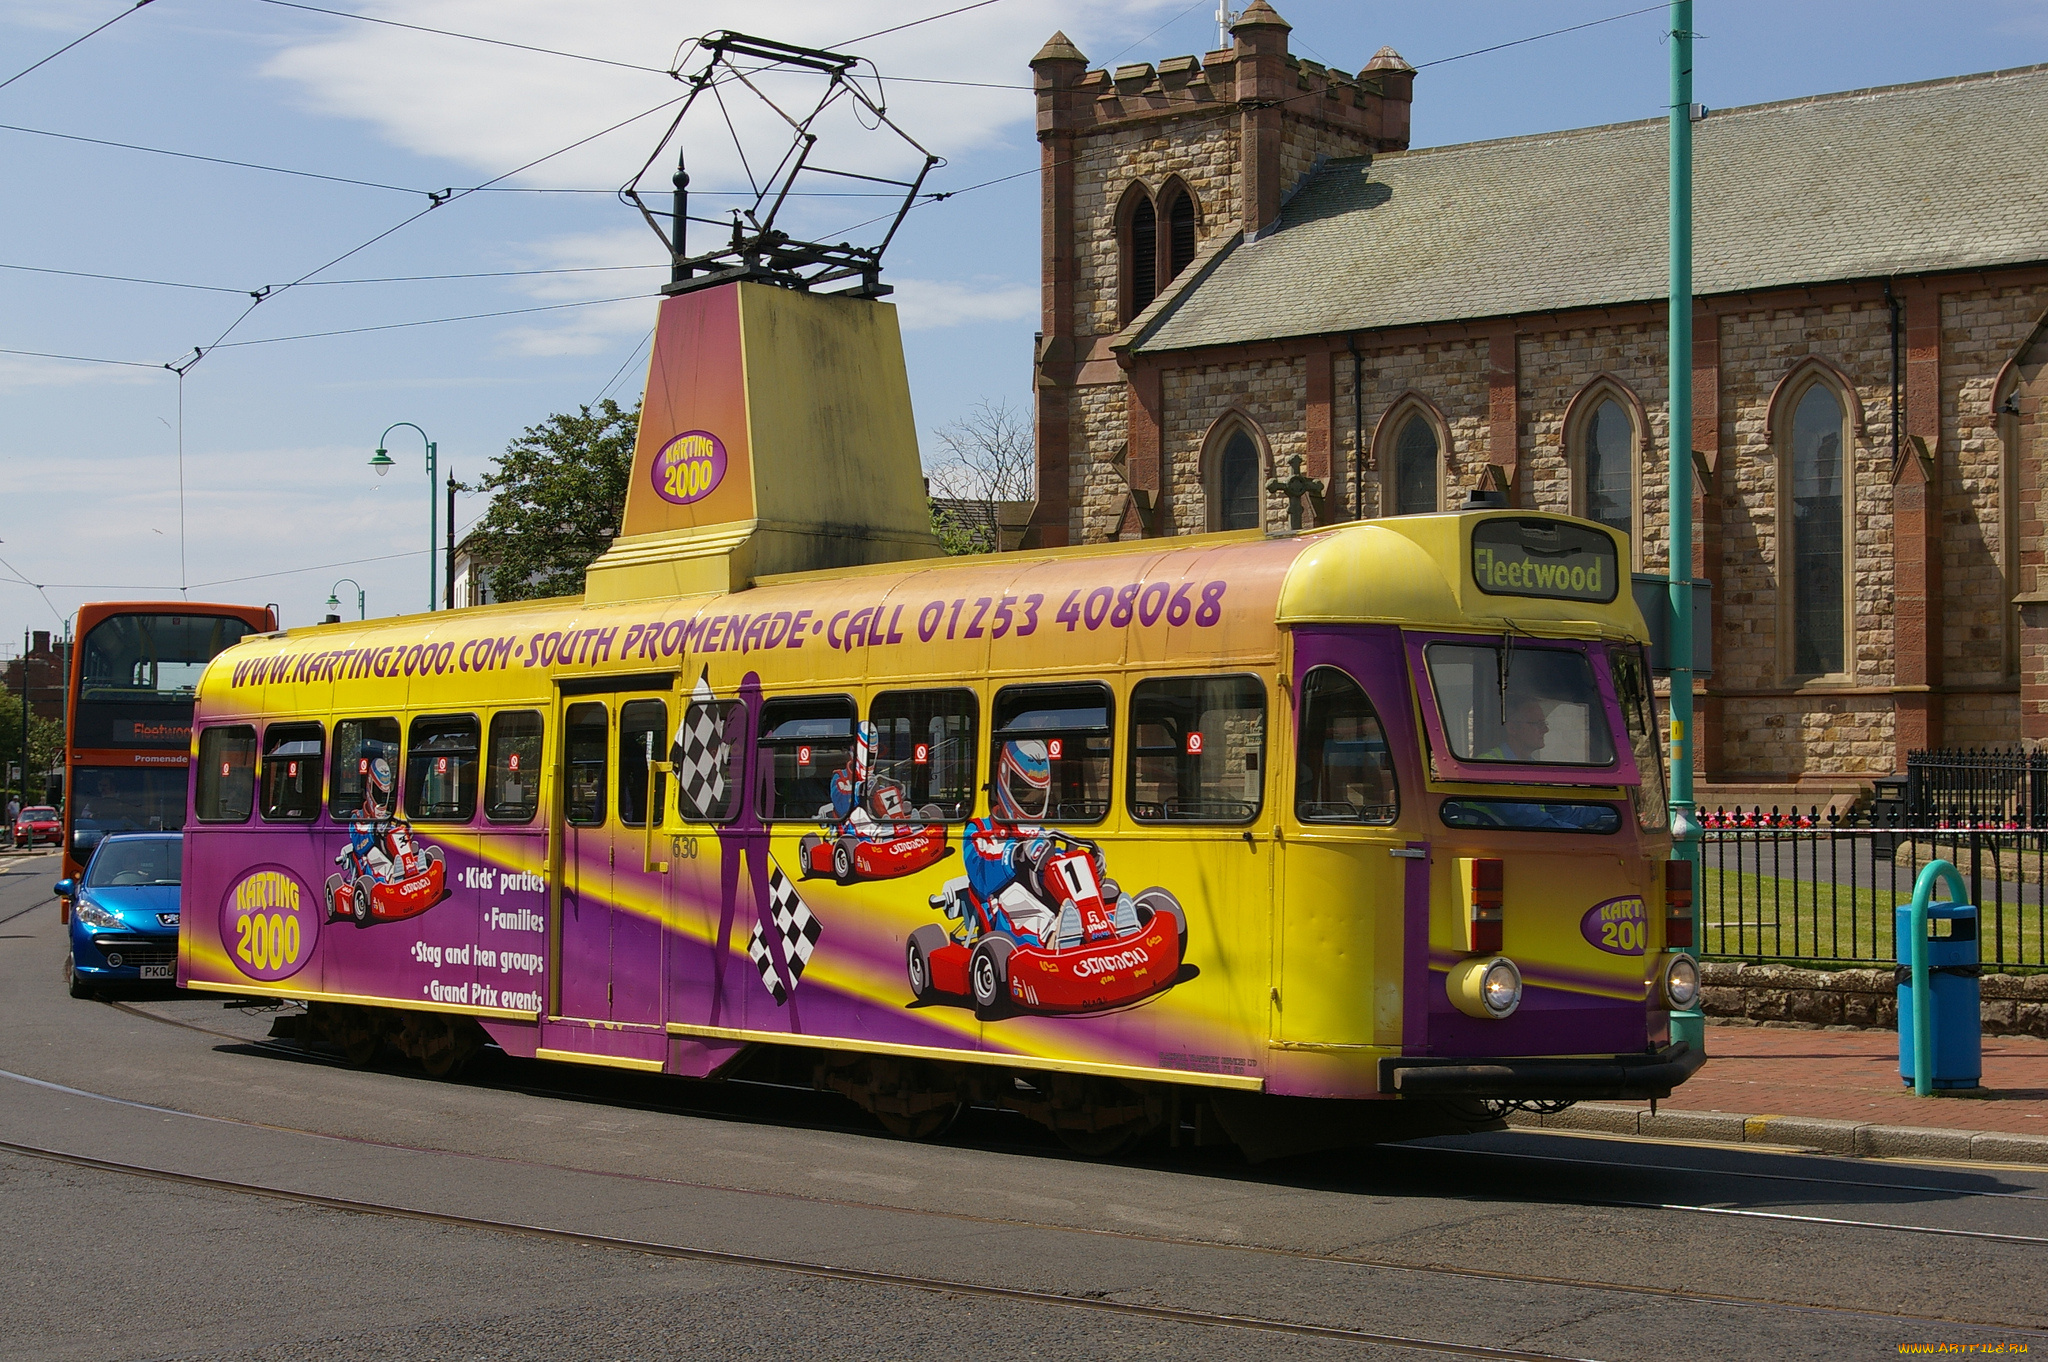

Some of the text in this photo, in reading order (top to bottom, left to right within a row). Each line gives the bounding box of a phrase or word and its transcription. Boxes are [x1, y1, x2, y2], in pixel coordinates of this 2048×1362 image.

[665, 435, 714, 464] KARTING
[664, 459, 712, 498] 2000
[1475, 548, 1602, 592] Fleetwood
[231, 580, 1227, 688] WWW.KARTING2000.COM SOUTH PROMENADE CALL 01253 408068
[134, 723, 193, 738] Fleetwoo
[135, 754, 188, 763] Promenade
[673, 836, 699, 859] 630
[236, 872, 300, 912] KARTING
[465, 867, 545, 894] Kids' parties
[1064, 860, 1083, 894] 1
[491, 907, 544, 933] Families
[1602, 921, 1645, 950] 200
[236, 913, 300, 971] 2000
[416, 941, 544, 976] Stag and hen groups
[430, 980, 543, 1013] Grand Prix events
